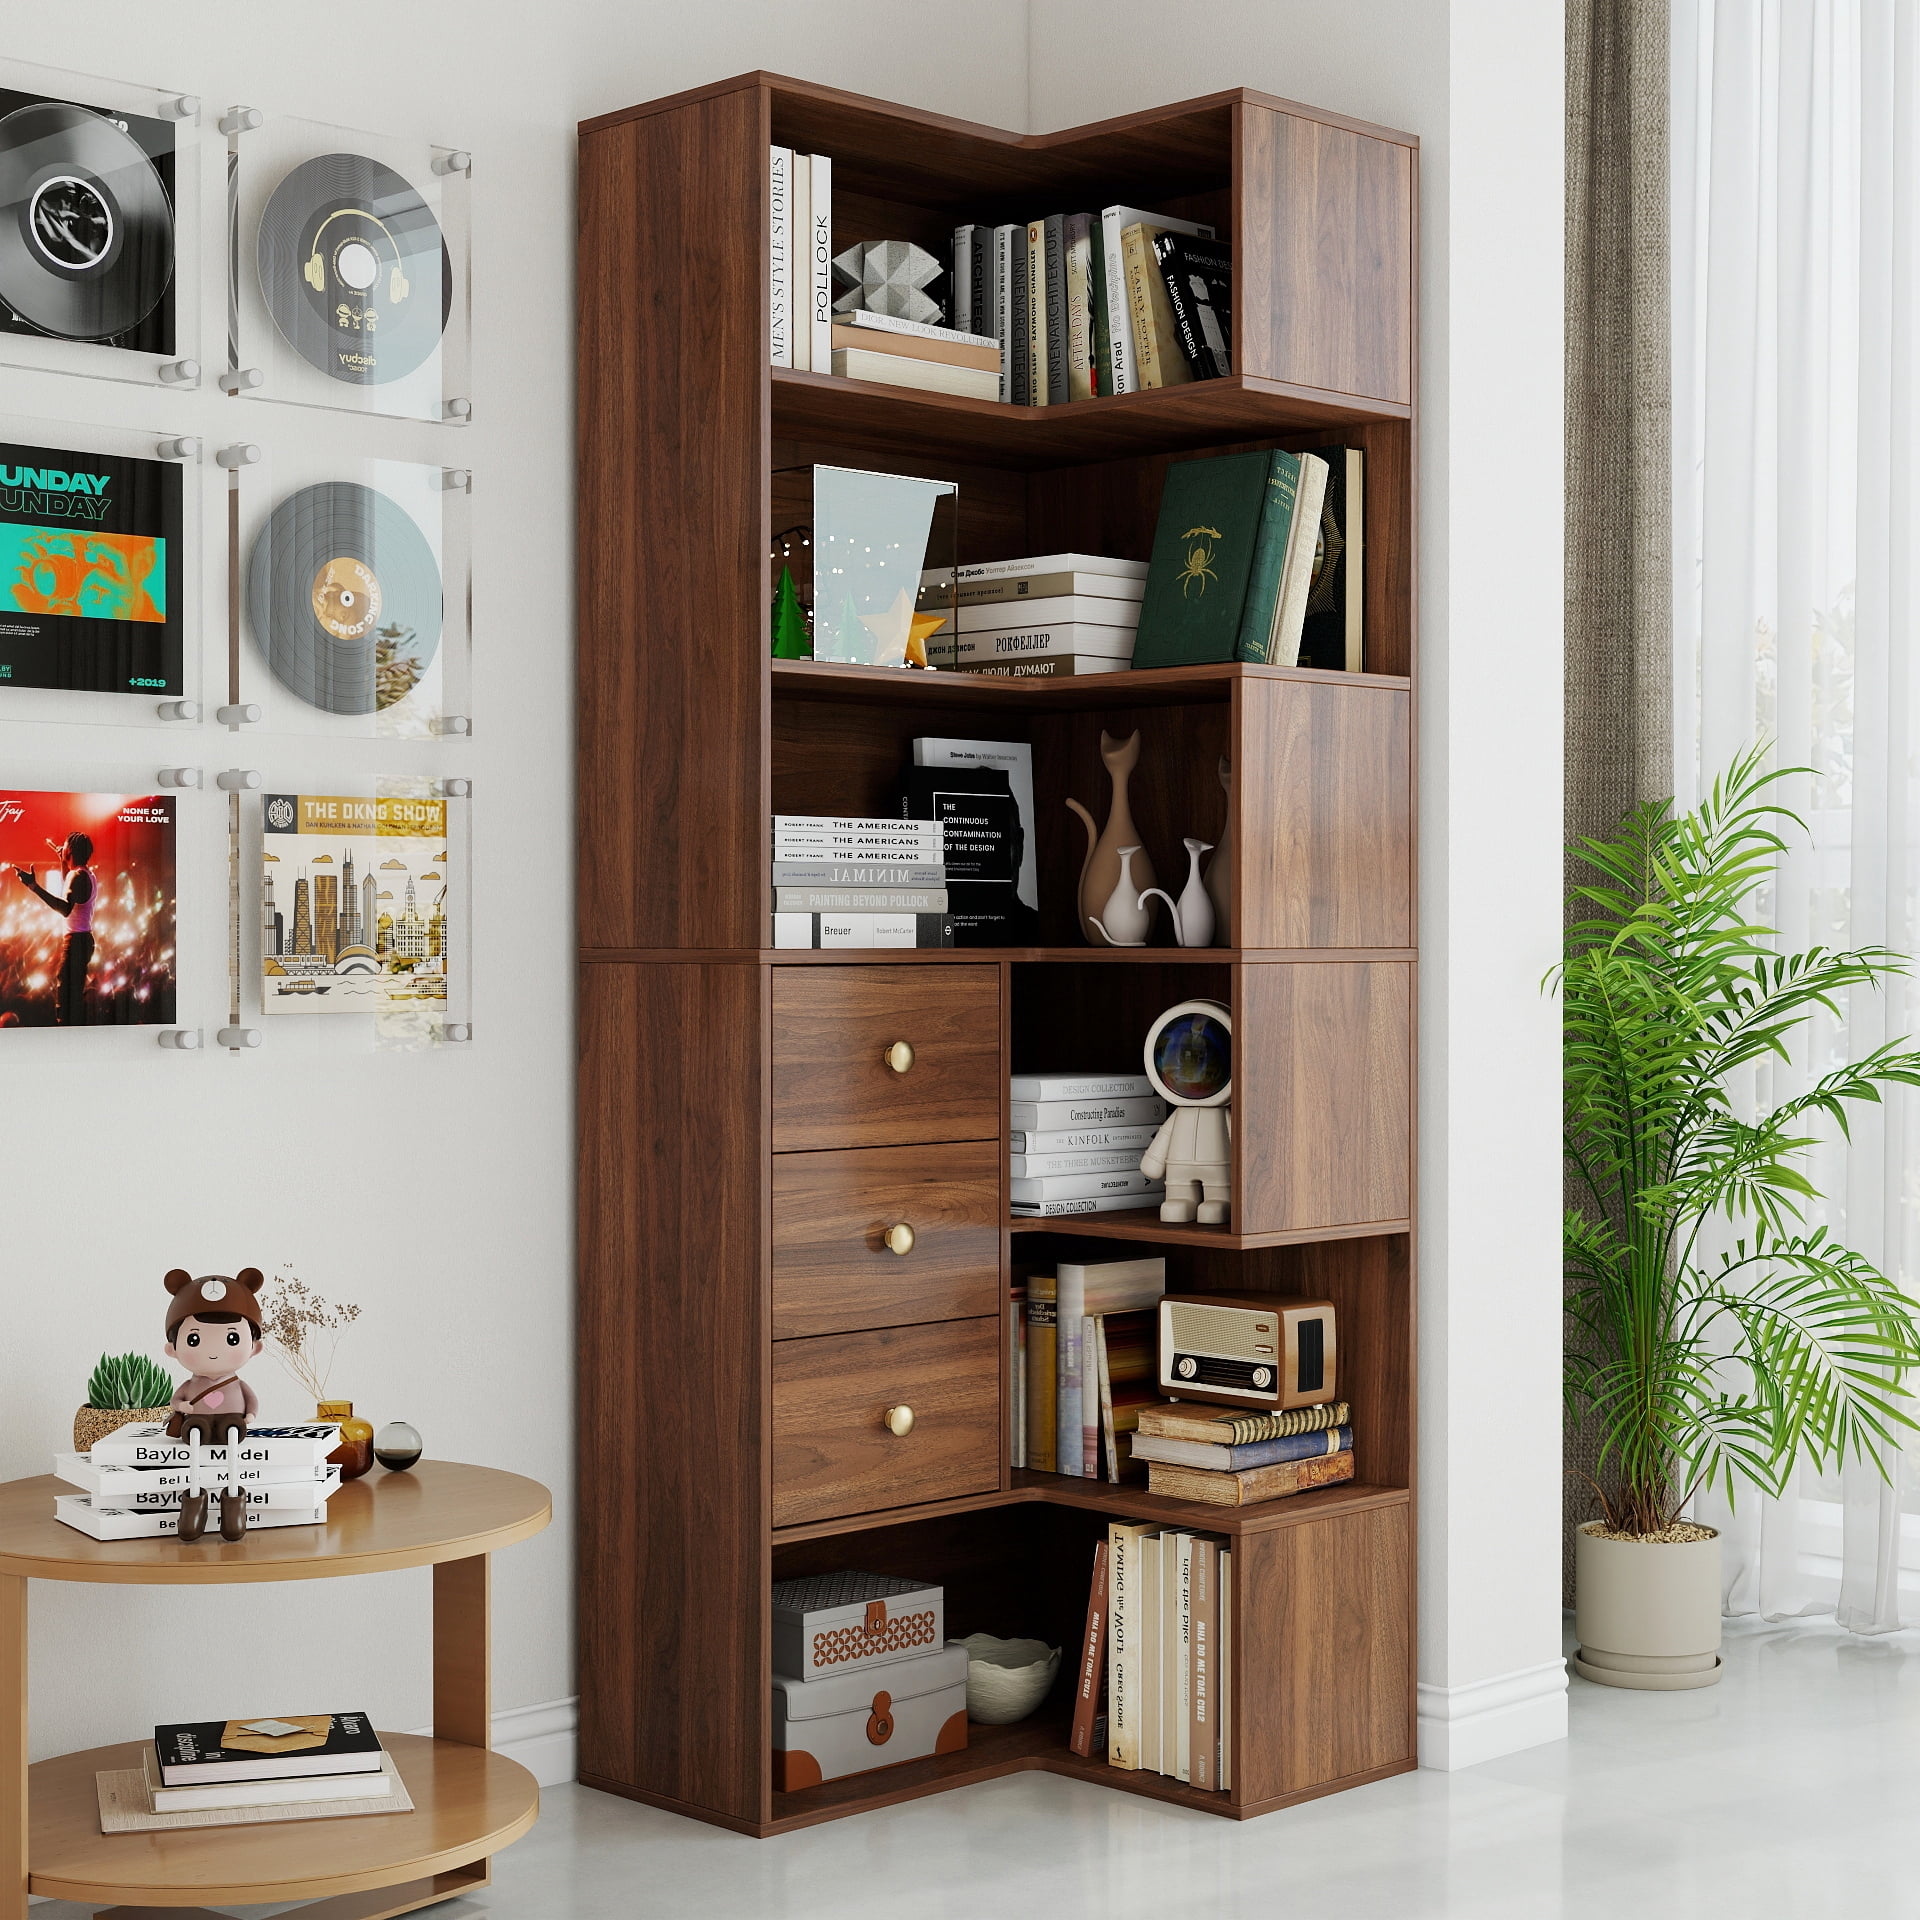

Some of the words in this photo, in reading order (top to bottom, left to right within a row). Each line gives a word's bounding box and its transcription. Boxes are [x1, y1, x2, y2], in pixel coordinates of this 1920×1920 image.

[772, 157, 784, 236] STORIES
[772, 240, 784, 298] STYLE
[816, 216, 828, 323] POLLOCK
[1046, 227, 1062, 390] INNENARCHITEKTUR
[1072, 295, 1081, 324] DAYS
[1133, 264, 1146, 316] HARRY
[1141, 318, 1153, 367] POTTER
[1166, 274, 1189, 318] FASHION
[1181, 319, 1198, 360] DESIGN
[772, 303, 784, 359] MEN'S
[888, 318, 910, 330] NEW
[912, 324, 936, 335] LOOK
[939, 328, 996, 348] REVOLUTION
[1073, 330, 1084, 371] AFTER
[1112, 341, 1123, 370] Arad
[1115, 371, 1126, 396] Ron
[0, 464, 111, 495] UNDAY
[0, 488, 112, 520] UNDAY
[330, 618, 365, 635] SONG
[928, 643, 946, 655] ДЖОН
[995, 633, 1051, 653] РОКФЕЛЛЕР
[1013, 662, 1056, 678] ДУМАЮТ
[128, 676, 167, 689] +2019
[122, 806, 148, 816] NONE
[151, 807, 165, 816] OF
[304, 801, 337, 819] THE
[342, 802, 387, 821] DKNG
[393, 804, 441, 822] SHOW
[942, 803, 956, 811] THE
[117, 815, 142, 824] YOUR
[145, 816, 170, 824] LOVE
[832, 822, 853, 830] THE
[857, 822, 919, 831] AMERICANS
[943, 816, 989, 826] CONTINUOUS
[832, 836, 853, 845] THE
[857, 837, 919, 846] AMERICANS
[943, 830, 1002, 839] CONTAMINATION
[955, 843, 968, 851] THE
[969, 844, 995, 852] DESIGN
[832, 851, 853, 860] THE
[857, 852, 919, 861] AMERICANS
[809, 893, 851, 906] PAINTING
[852, 893, 888, 907] BEYOND
[889, 894, 929, 908] POLLOCK
[824, 926, 852, 936] Breuer
[892, 927, 914, 935] McCarter
[1062, 1083, 1090, 1095] DESIGN
[1090, 1082, 1135, 1094] COLLECTION
[1070, 1108, 1103, 1122] Constructing
[1067, 1133, 1110, 1146] KINFOLK
[1046, 1159, 1062, 1169] THE
[1064, 1157, 1089, 1168] THREE
[1090, 1155, 1139, 1167] MUSKETEERS
[1045, 1203, 1065, 1215] DESIGN
[1066, 1200, 1097, 1213] COLLECTION
[136, 1446, 190, 1465] Baylo
[210, 1448, 269, 1461] Mdel
[159, 1475, 181, 1485] Bel
[217, 1470, 260, 1481] Mdel
[210, 1492, 269, 1504] Mel
[159, 1519, 179, 1529] Be
